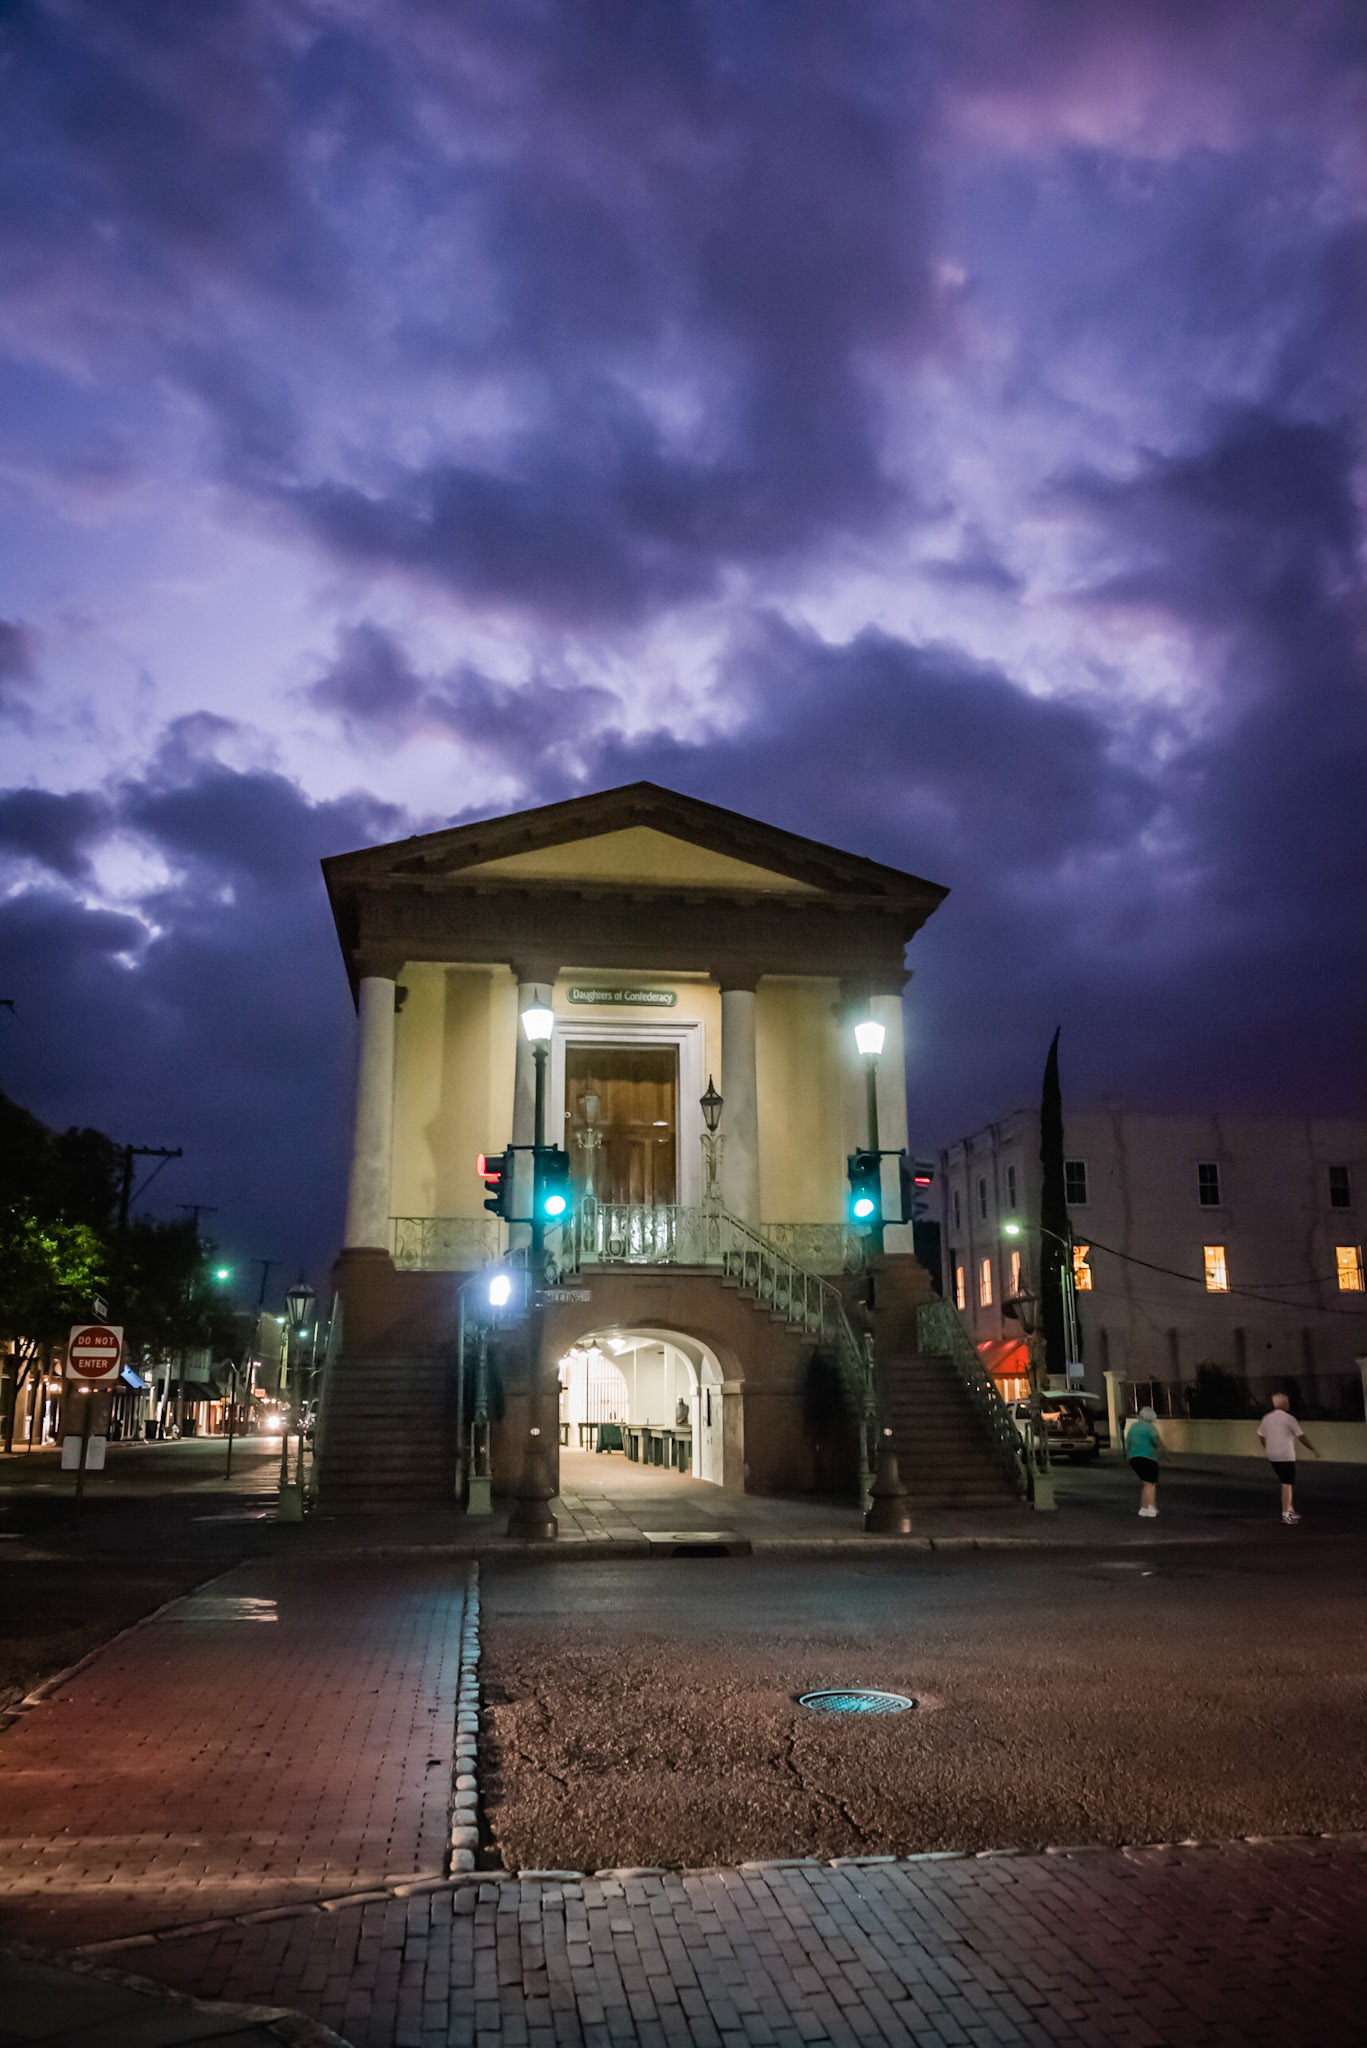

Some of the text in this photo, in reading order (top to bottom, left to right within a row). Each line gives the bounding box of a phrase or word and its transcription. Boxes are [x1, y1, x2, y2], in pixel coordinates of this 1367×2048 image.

[573, 989, 673, 1005] Daughters of Confederacy
[78, 1336, 114, 1345] DO NOT
[78, 1359, 108, 1369] ENTER
